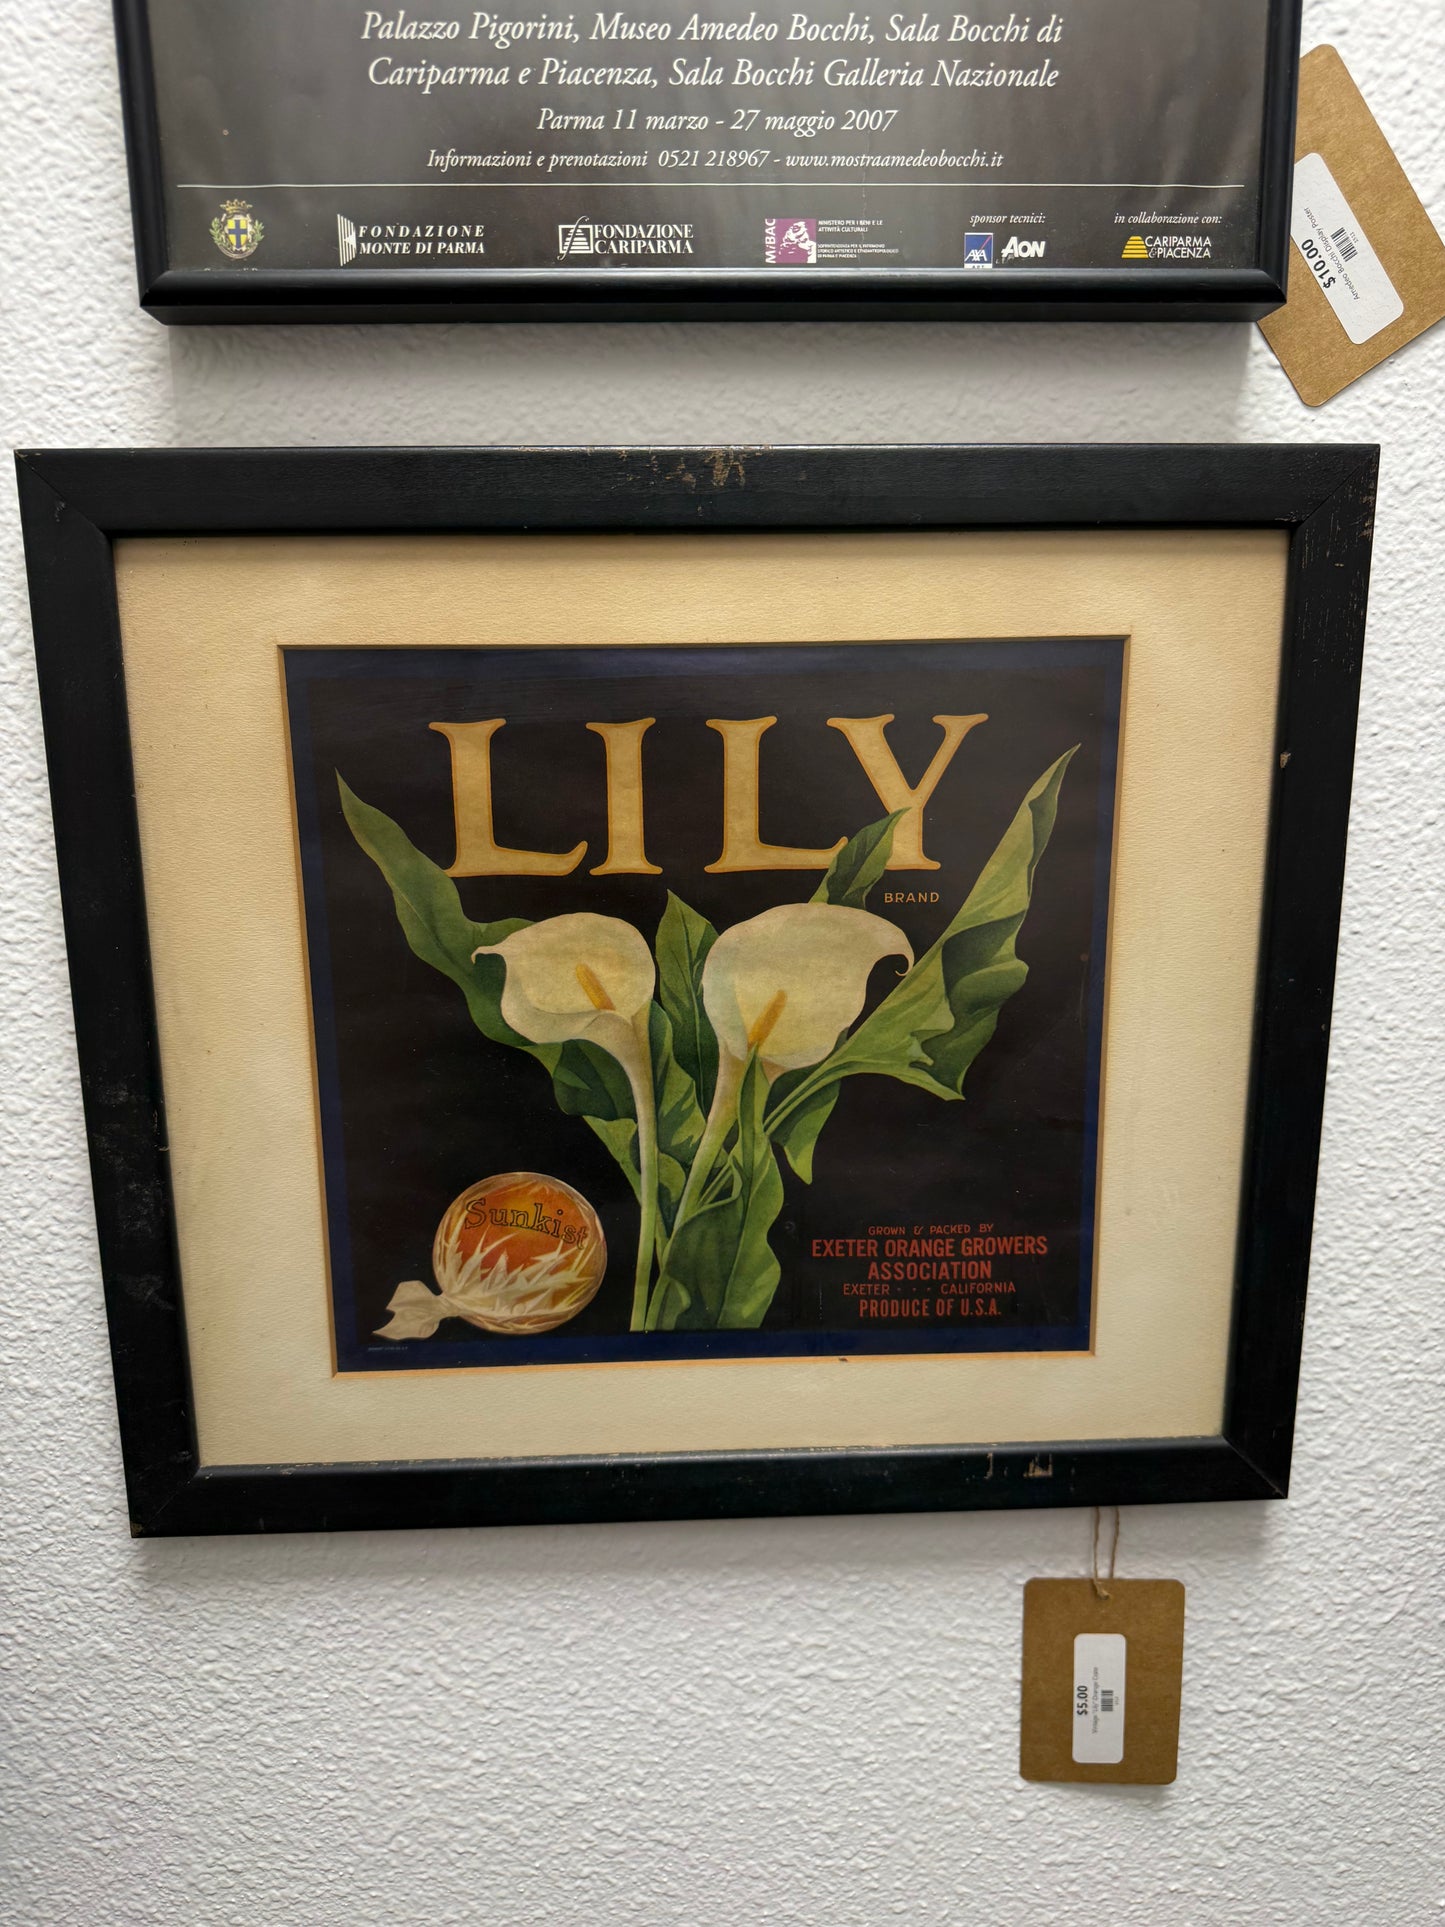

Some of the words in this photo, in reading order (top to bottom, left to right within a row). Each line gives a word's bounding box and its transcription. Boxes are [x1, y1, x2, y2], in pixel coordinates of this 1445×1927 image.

[360, 11, 460, 41] Palazzo
[468, 12, 580, 50] Pigorini,
[590, 12, 671, 41] Museo
[677, 12, 778, 41] Amedeo
[787, 13, 875, 45] Bocchi,
[885, 14, 940, 43] Sala
[947, 14, 1030, 43] Bocchi
[1036, 14, 1065, 43] di
[368, 57, 509, 94] Cariparma
[517, 65, 531, 86] e
[538, 58, 659, 89] Piacenza,
[668, 58, 724, 86] Sala
[732, 58, 814, 86] Bocchi
[824, 58, 924, 87] Galleria
[931, 58, 1060, 87] Nazionale
[536, 107, 605, 130] Parma
[612, 108, 635, 130] 11
[645, 115, 709, 130] marzo
[729, 109, 760, 130] 27
[764, 110, 836, 138] maggio
[840, 109, 899, 131] 2007
[427, 149, 532, 172] Informazioni
[536, 156, 546, 167] e
[547, 149, 648, 176] prenotazioni
[658, 150, 700, 168] 0521
[704, 150, 770, 167] 218967
[785, 151, 1004, 169] www.mostraamedeobocchi.it
[970, 214, 1008, 227] sponsor
[1010, 213, 1046, 223] tecnici:
[1113, 212, 1125, 223] in
[1128, 211, 1199, 224] collaborazione
[1201, 215, 1223, 224] con:
[1304, 207, 1318, 229] Poster
[358, 225, 485, 238] FONDAZIONE
[594, 224, 694, 238] FONDAZIONE
[1145, 235, 1212, 247] CARIPARMA
[1316, 228, 1333, 252] Display
[360, 242, 411, 254] MONTE
[415, 242, 432, 254] DI
[437, 242, 485, 254] PARMA
[594, 240, 694, 254] CARIPARMA
[965, 249, 987, 262] AXA
[1301, 238, 1336, 289] $10.00
[1329, 249, 1344, 274] Bocchi
[1343, 271, 1360, 300] Amedeo
[428, 713, 988, 878] LILY
[884, 892, 940, 904] BRAND
[464, 1197, 589, 1250] Sunkist
[868, 1226, 906, 1236] GROWN
[913, 1225, 924, 1236] &
[929, 1224, 971, 1235] PACKED
[979, 1223, 994, 1233] BY
[811, 1239, 879, 1257] EXETER
[884, 1238, 955, 1257] ORANGE
[961, 1236, 1048, 1256] GROWERS
[868, 1261, 992, 1280] ASSOCIATION
[843, 1284, 890, 1295] EXETER
[940, 1281, 1016, 1294] CALIFORNIA
[859, 1299, 930, 1317] PRODUCE
[936, 1298, 954, 1317] OF
[960, 1298, 1002, 1316] U.S.A.
[1076, 1685, 1089, 1716] $5.00
